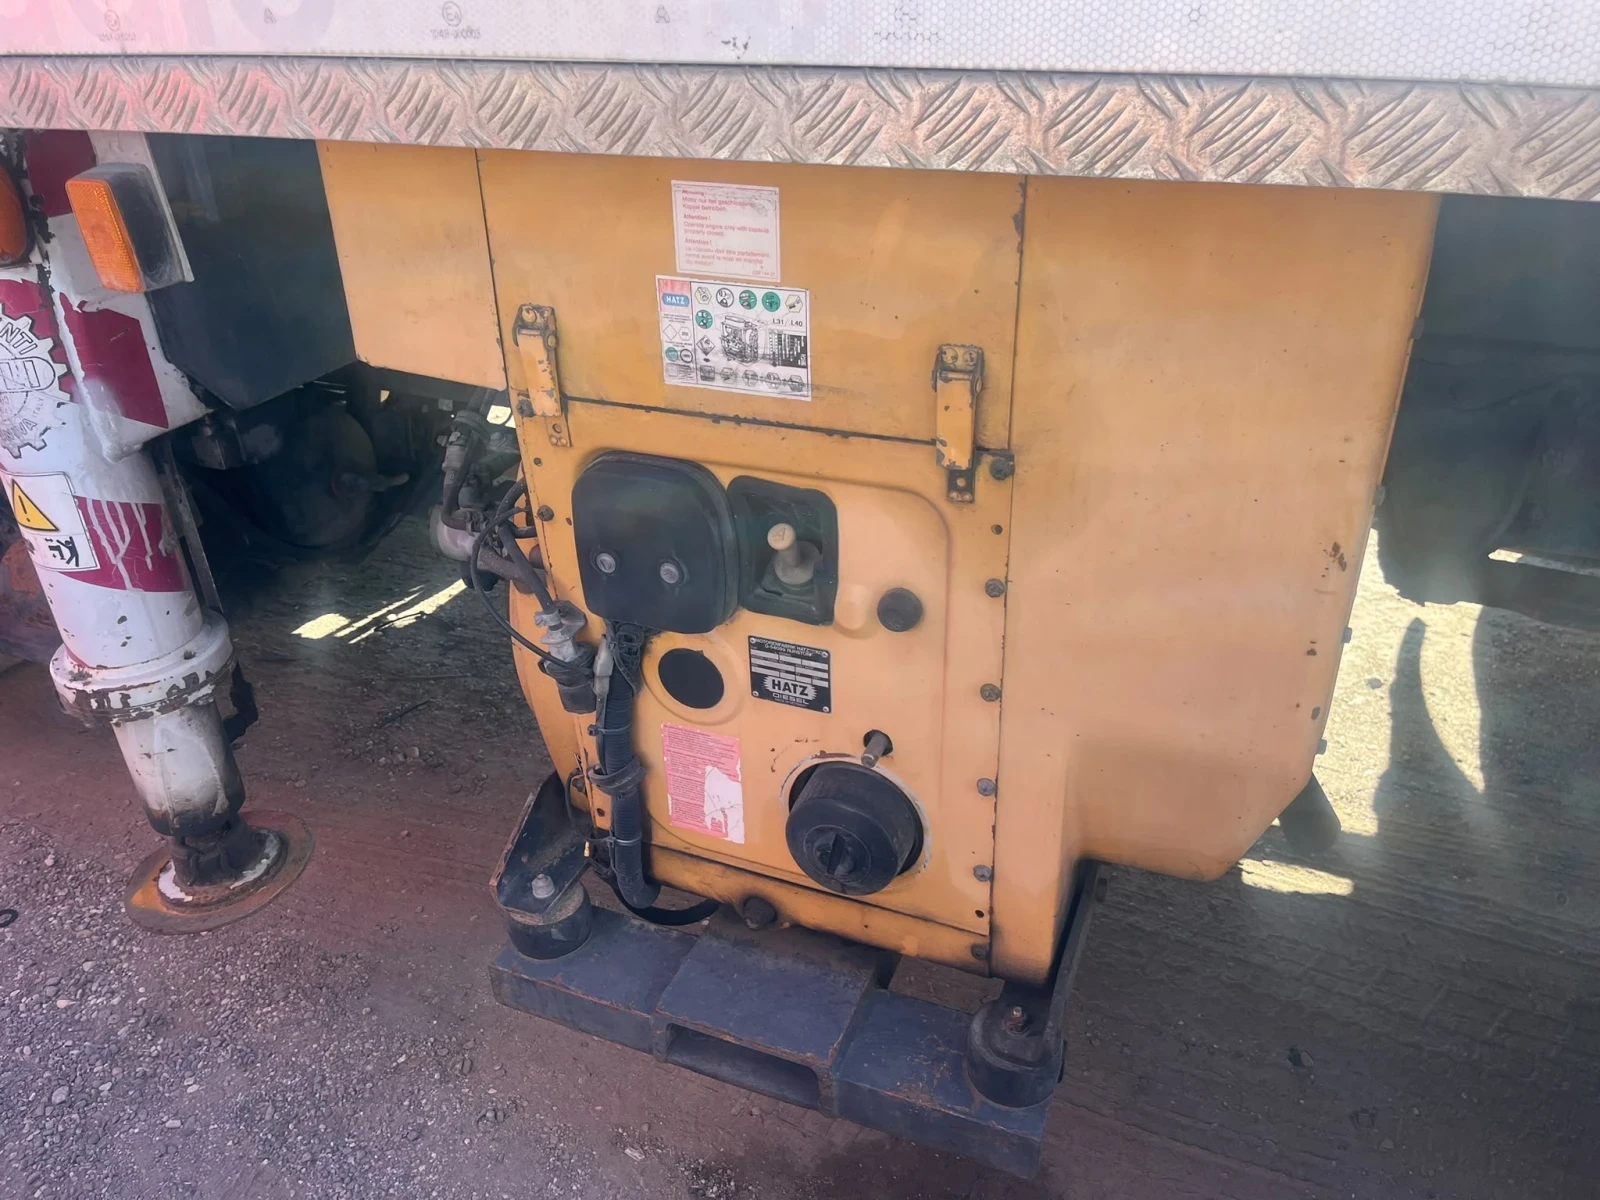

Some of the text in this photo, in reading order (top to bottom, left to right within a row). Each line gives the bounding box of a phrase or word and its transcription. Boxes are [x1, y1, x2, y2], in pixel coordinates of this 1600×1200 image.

[706, 223, 722, 231] engine
[724, 224, 735, 232] only
[666, 296, 686, 305] HATZ
[772, 318, 785, 326] L31
[790, 319, 803, 328] L40
[32, 397, 44, 418] ITALY
[772, 679, 809, 697] HATZ
[772, 692, 810, 705] DIESEL
